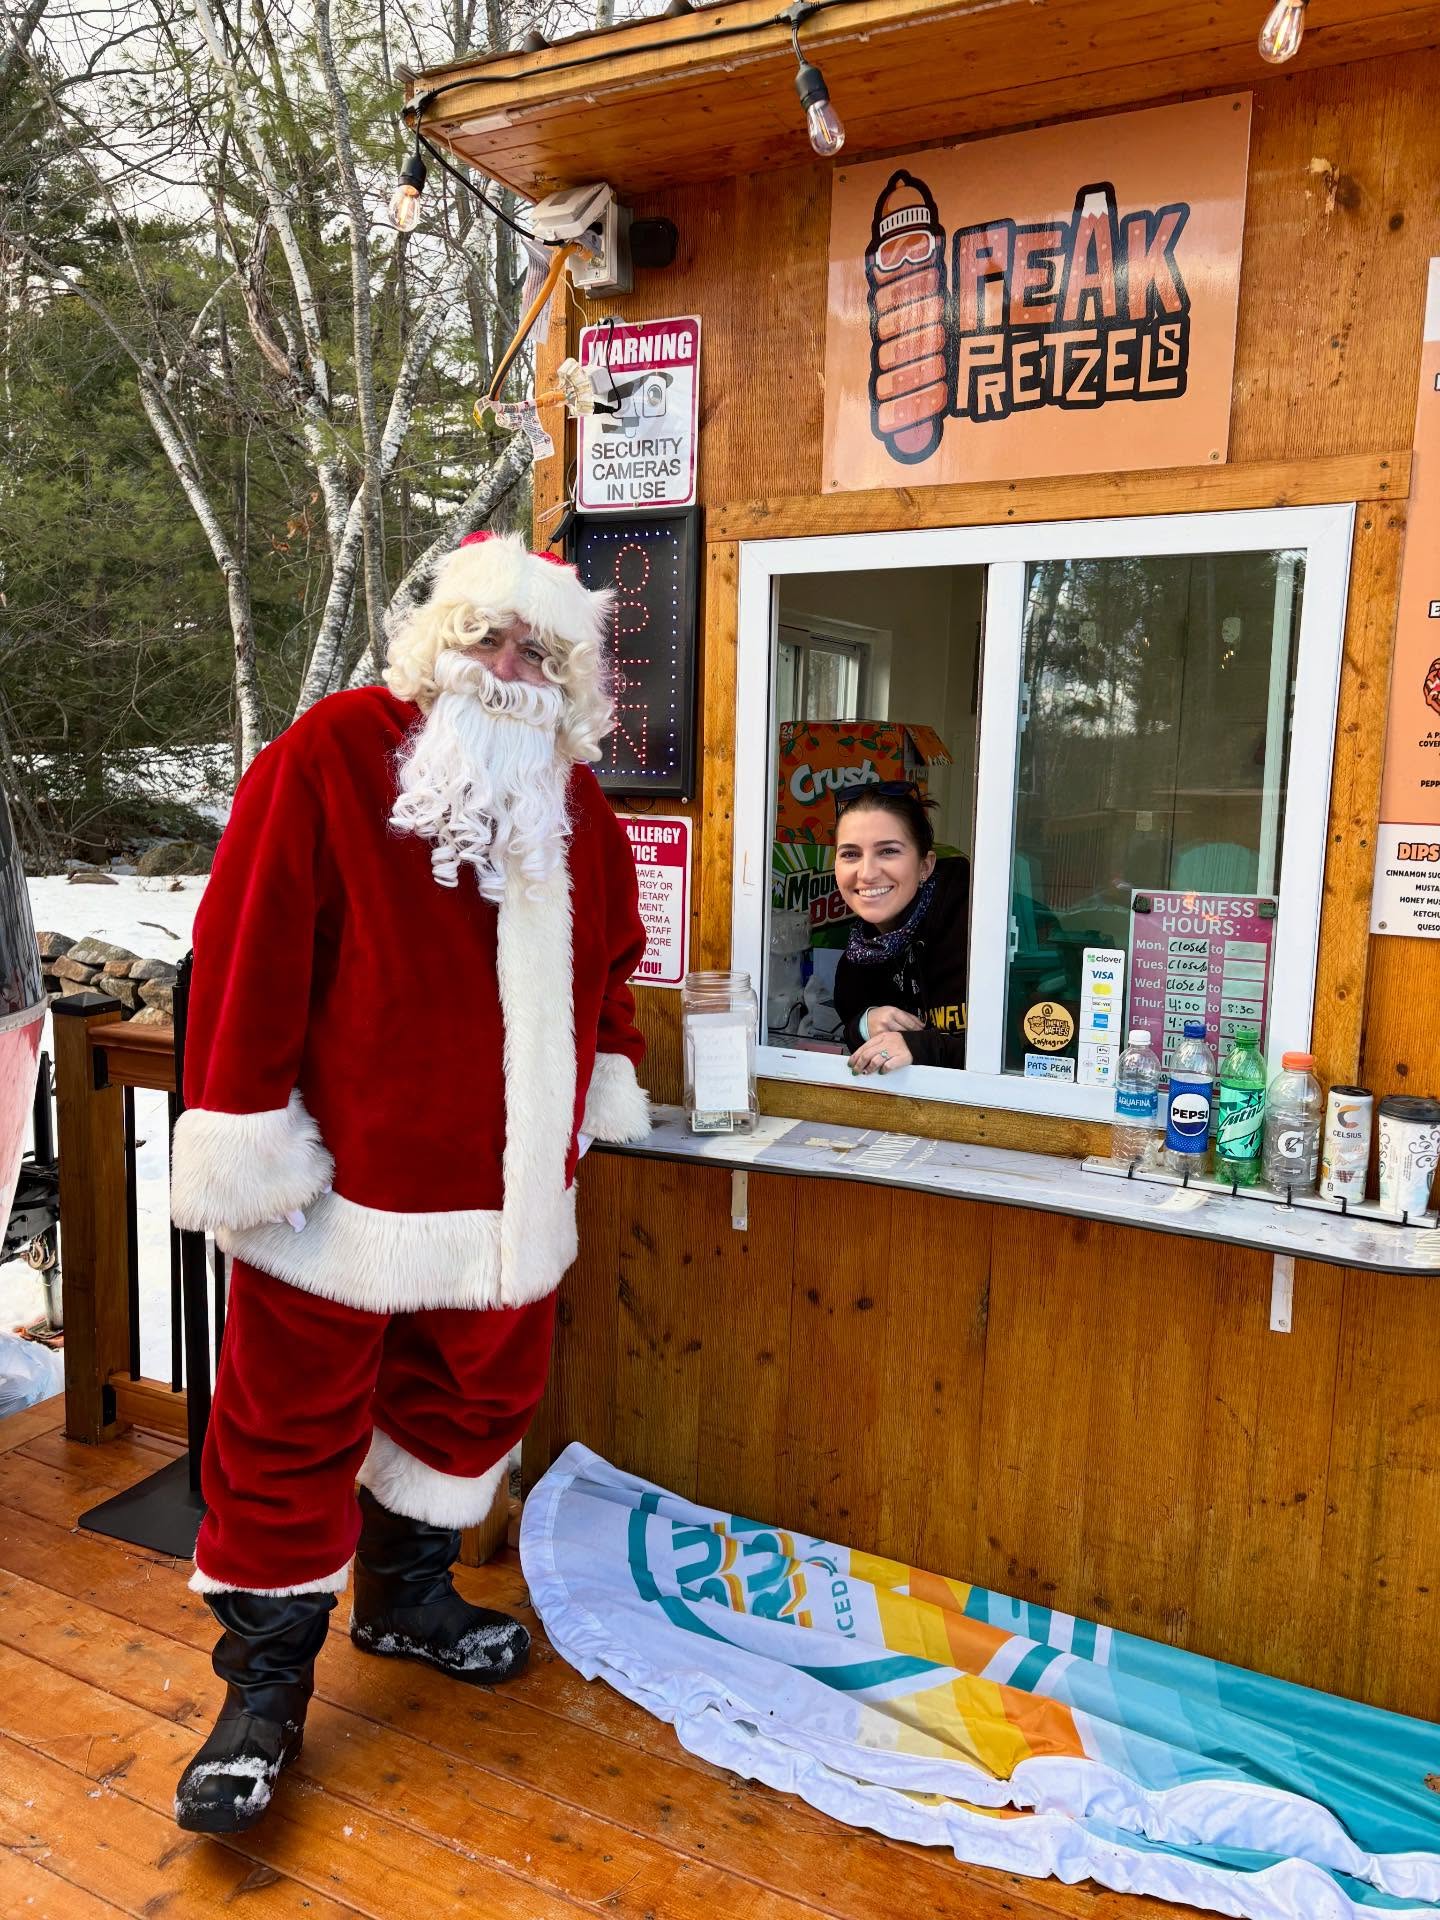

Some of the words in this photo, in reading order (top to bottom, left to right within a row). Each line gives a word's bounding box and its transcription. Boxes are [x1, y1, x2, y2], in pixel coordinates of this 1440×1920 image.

[957, 189, 1186, 332] PEAK
[588, 331, 693, 367] WARNING
[956, 323, 1182, 415] PRETZELS
[591, 437, 683, 460] SECURITY
[592, 459, 681, 481] CAMERAS
[607, 483, 624, 501] IN
[630, 481, 666, 500] USE
[612, 543, 650, 765] OPEN
[790, 759, 880, 803] Crush
[626, 825, 681, 844] ALLERGY
[631, 845, 658, 862] TICE
[1397, 842, 1440, 862] DIPS
[1386, 869, 1427, 879] CINNAMON
[660, 882, 673, 891] OR
[1415, 884, 1440, 892] MUSTA
[639, 891, 670, 901] IETARY
[1399, 896, 1425, 905] HONEY
[1153, 898, 1255, 918] BUSINESS
[1413, 910, 1440, 919] KETCHU
[646, 926, 672, 935] STAFF
[1162, 916, 1241, 936] HOURS:
[1136, 939, 1165, 951] Mon.
[1211, 945, 1223, 955] to
[638, 961, 662, 974] YOU!
[1096, 955, 1122, 964] clover
[1136, 959, 1167, 970] Tues.
[1210, 964, 1222, 974] to
[1092, 970, 1114, 980] VISA
[1135, 978, 1164, 989] Wed.
[1208, 984, 1221, 994] to
[1134, 997, 1165, 1008] Thur.
[1169, 1001, 1200, 1011] 4:00
[1207, 1003, 1220, 1013] to
[1227, 1003, 1255, 1014] 8:30
[1133, 1016, 1151, 1026] Fri.
[1206, 1022, 1218, 1032] to
[1027, 1061, 1047, 1071] PATS
[1050, 1063, 1072, 1074] PEAK
[1119, 1096, 1151, 1107] AQUAFINA
[1172, 1107, 1209, 1120] PEPSI
[1333, 1130, 1362, 1139] CELSIUS
